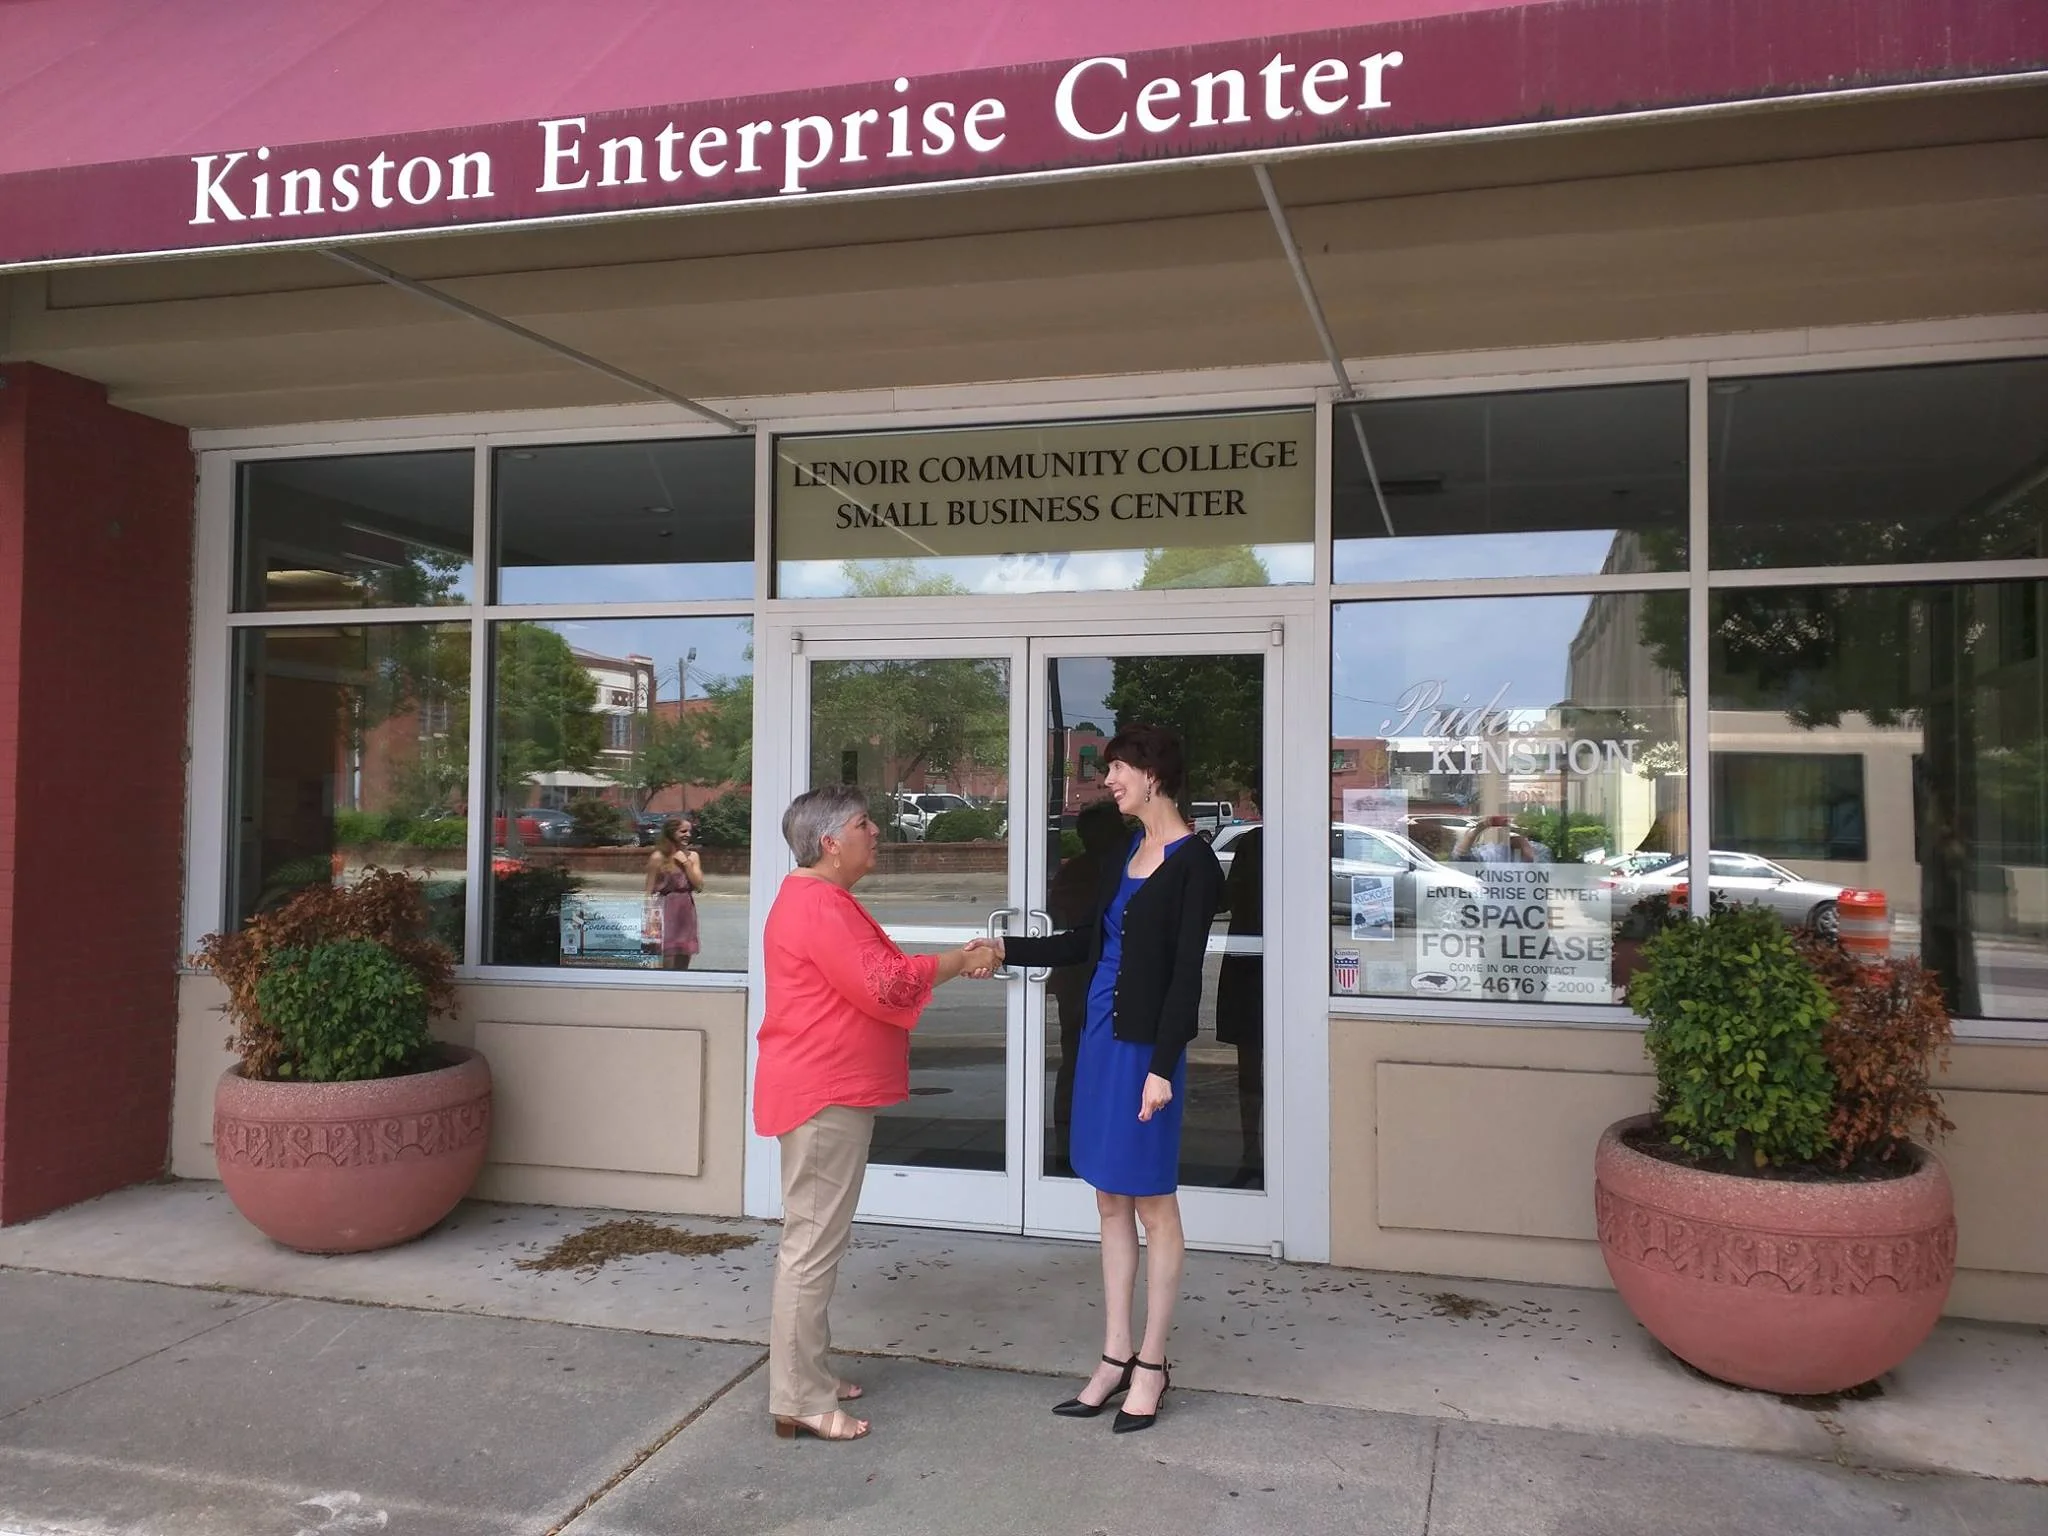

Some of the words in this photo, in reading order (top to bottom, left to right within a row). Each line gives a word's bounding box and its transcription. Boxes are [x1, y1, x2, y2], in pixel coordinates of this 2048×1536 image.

[188, 146, 495, 226] Kinston
[535, 77, 1007, 194] Enterprise
[1054, 56, 1405, 141] Center
[794, 458, 911, 488] LENOIR
[919, 448, 1130, 482] COMMUNITY
[1137, 440, 1298, 474] COLLEGE
[836, 501, 938, 529] SMALL
[947, 494, 1100, 525] BUSINESS
[1111, 488, 1247, 518] CENTER
[1379, 678, 1520, 740] Pride
[1429, 738, 1641, 776] KINSTON
[1475, 869, 1550, 884] KINSTON
[1533, 887, 1600, 902] CENTER
[1460, 904, 1565, 930] SPACE
[1422, 933, 1486, 958] FOR
[1501, 935, 1606, 962] LEASE
[1449, 962, 1484, 974] COME
[1487, 964, 1499, 973] IN
[1502, 965, 1519, 974] OR
[1523, 965, 1577, 976] CONTACT
